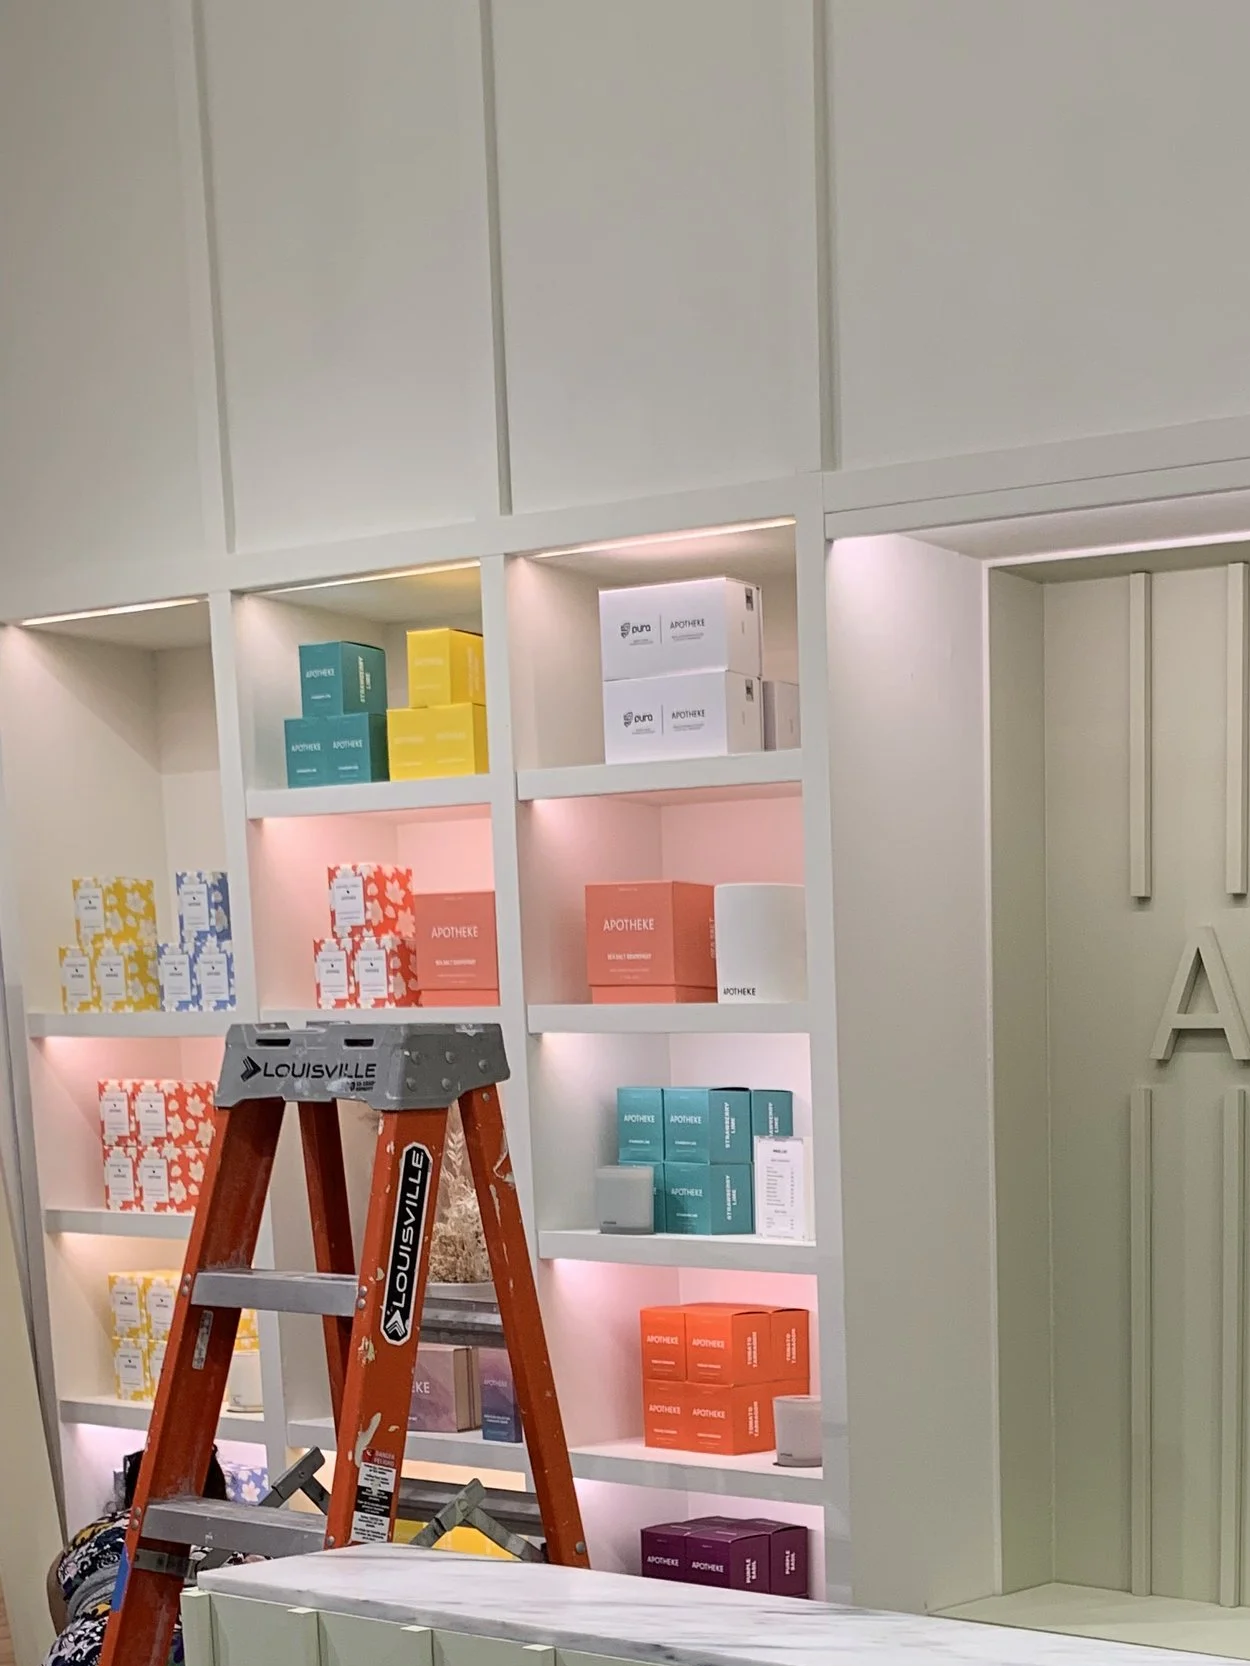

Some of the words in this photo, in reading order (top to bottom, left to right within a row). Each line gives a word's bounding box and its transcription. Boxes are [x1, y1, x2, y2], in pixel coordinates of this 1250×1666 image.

[631, 623, 652, 635] pura
[670, 618, 705, 630] APOTHEKE
[305, 668, 335, 679] APOTHEKE
[634, 712, 653, 724] pura
[671, 709, 705, 720] APOTHEKE
[291, 743, 321, 754] APOTHEKE
[333, 739, 363, 750] APOTHEKE
[603, 918, 655, 932] APOTHEKE
[431, 926, 479, 938] APOTHEKE
[723, 987, 757, 996] APOTHEKE
[262, 1061, 378, 1079] LOUISVILLE
[623, 1114, 656, 1125] APOTHEKE
[669, 1114, 703, 1125] APOTHEKE
[670, 1187, 704, 1198] APOTHEKE
[392, 1150, 424, 1309] LOUISVILLE
[646, 1334, 681, 1346] APOTHEKE
[691, 1338, 726, 1350] APOTHEKE
[648, 1403, 683, 1416] APOTHEKE
[692, 1407, 727, 1420] APOTHEKE
[647, 1555, 681, 1568] APOTHEKE
[691, 1561, 725, 1574] APOTHEKE
